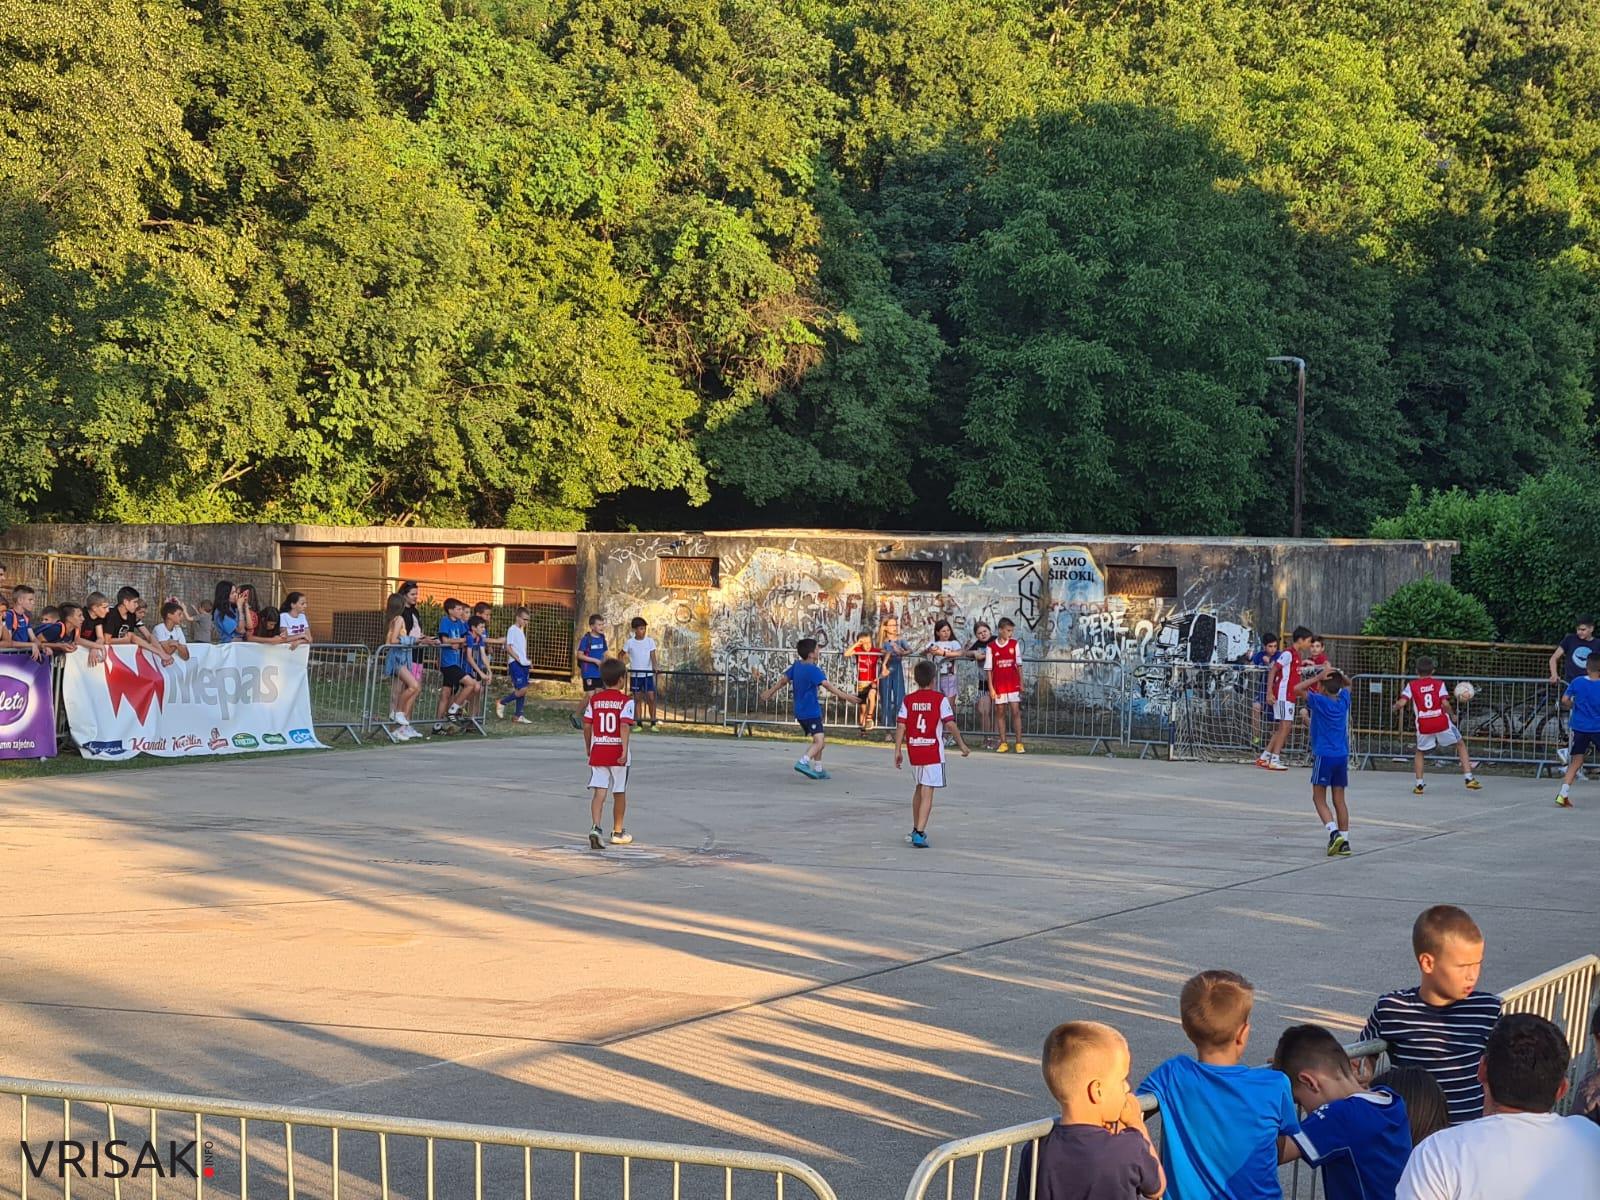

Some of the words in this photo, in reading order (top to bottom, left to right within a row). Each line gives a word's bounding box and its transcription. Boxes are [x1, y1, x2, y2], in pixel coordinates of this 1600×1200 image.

[1052, 556, 1087, 567] SAMO
[166, 656, 279, 721] Mepas
[1424, 693, 1433, 709] 8
[598, 712, 616, 733] 10
[916, 713, 926, 733] 4
